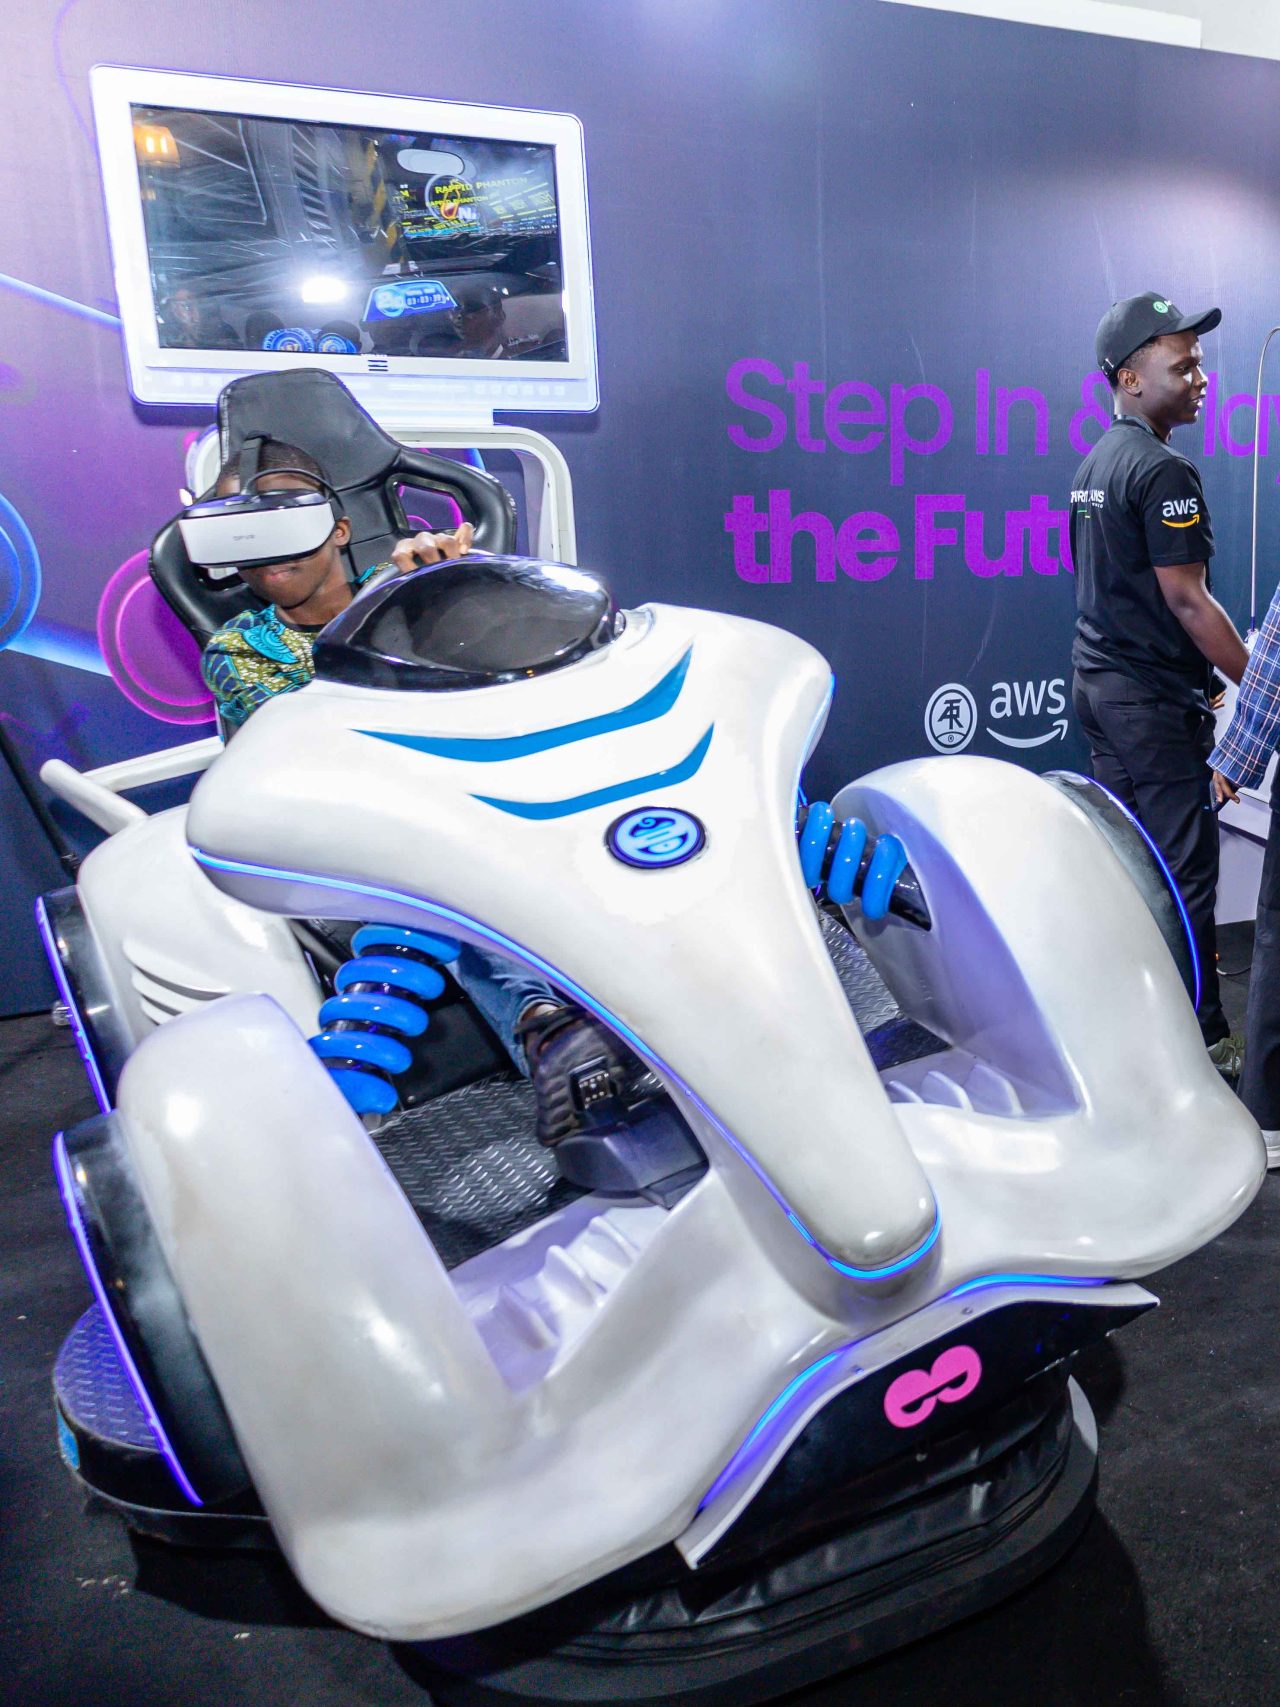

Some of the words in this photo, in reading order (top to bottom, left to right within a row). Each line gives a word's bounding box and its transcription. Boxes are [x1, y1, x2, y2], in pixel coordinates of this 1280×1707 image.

[725, 357, 954, 486] Step
[976, 368, 1048, 456] In
[724, 489, 900, 584] the
[914, 494, 1075, 578] Fut
[1162, 497, 1199, 517] aws
[989, 678, 1067, 719] aws
